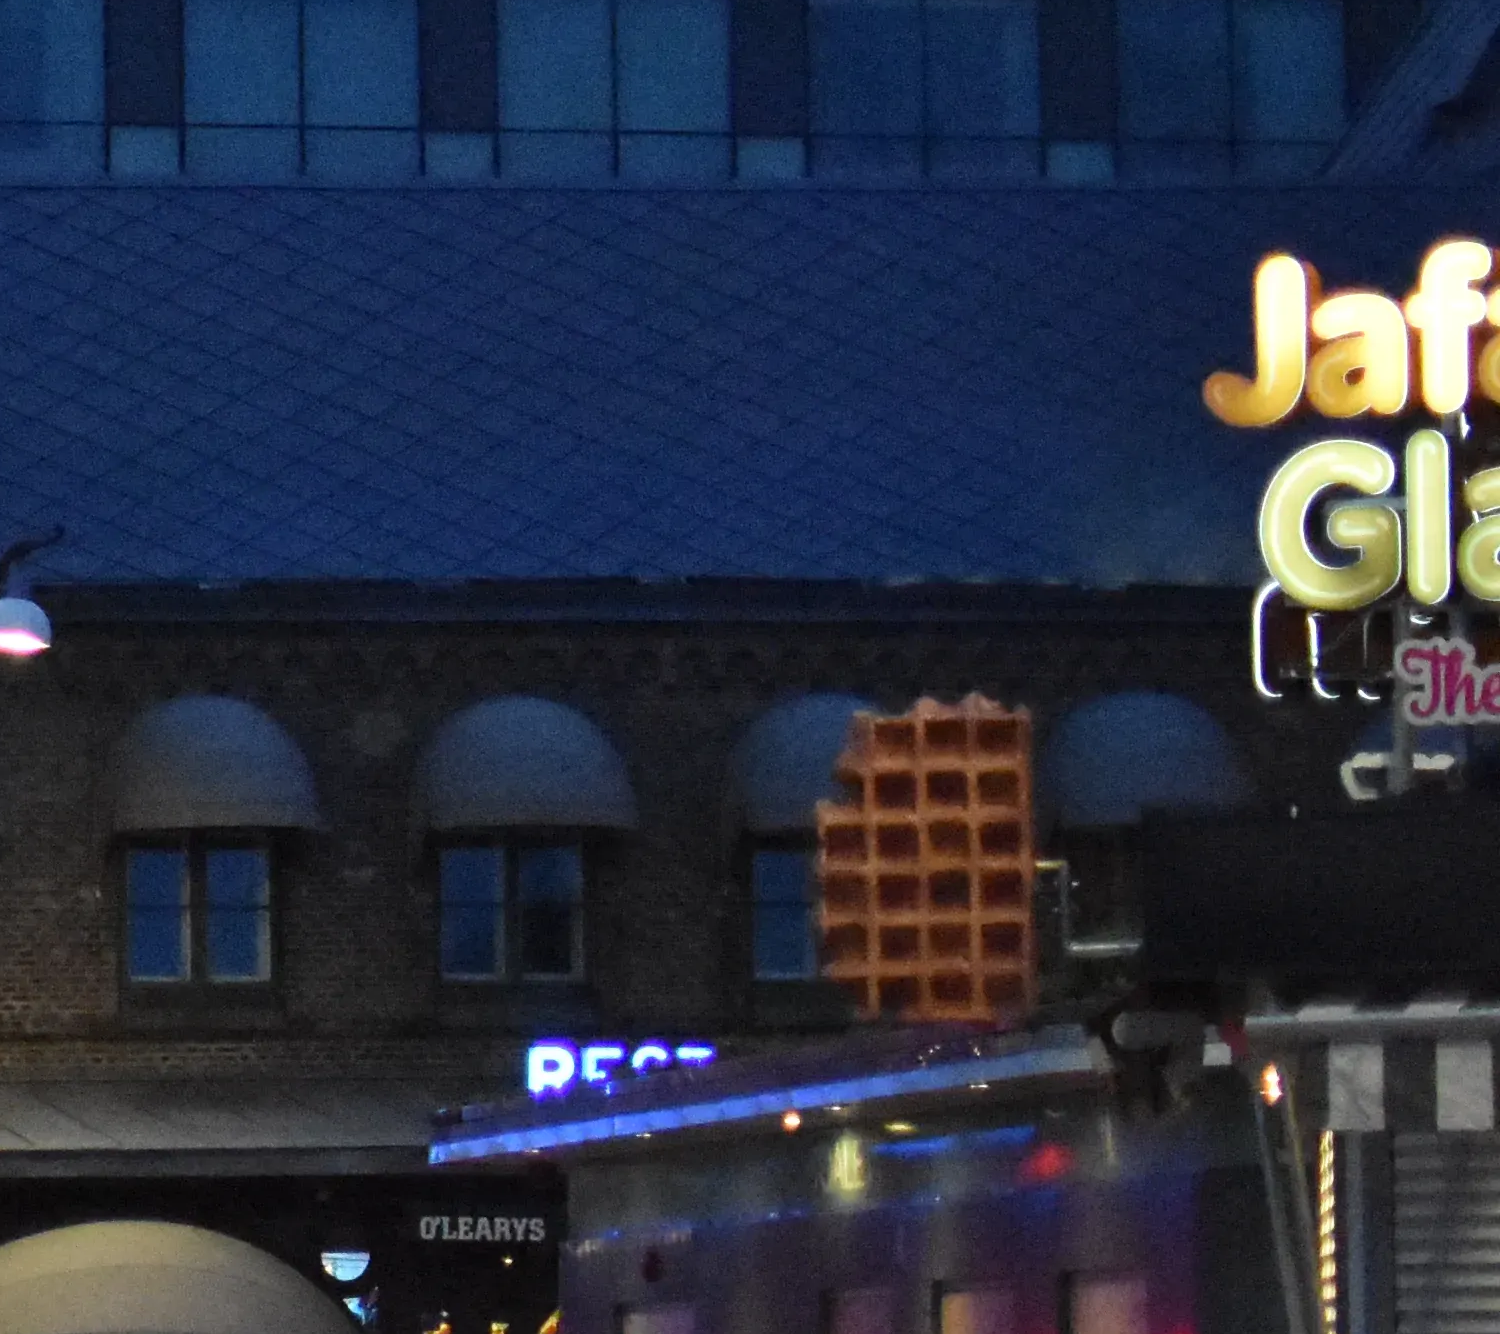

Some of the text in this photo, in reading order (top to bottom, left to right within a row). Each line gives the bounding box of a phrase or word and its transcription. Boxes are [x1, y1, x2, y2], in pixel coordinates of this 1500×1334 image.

[1203, 238, 1500, 427] Jaf
[525, 1040, 716, 1095] RE
[419, 1216, 545, 1243] O'LEARYS
